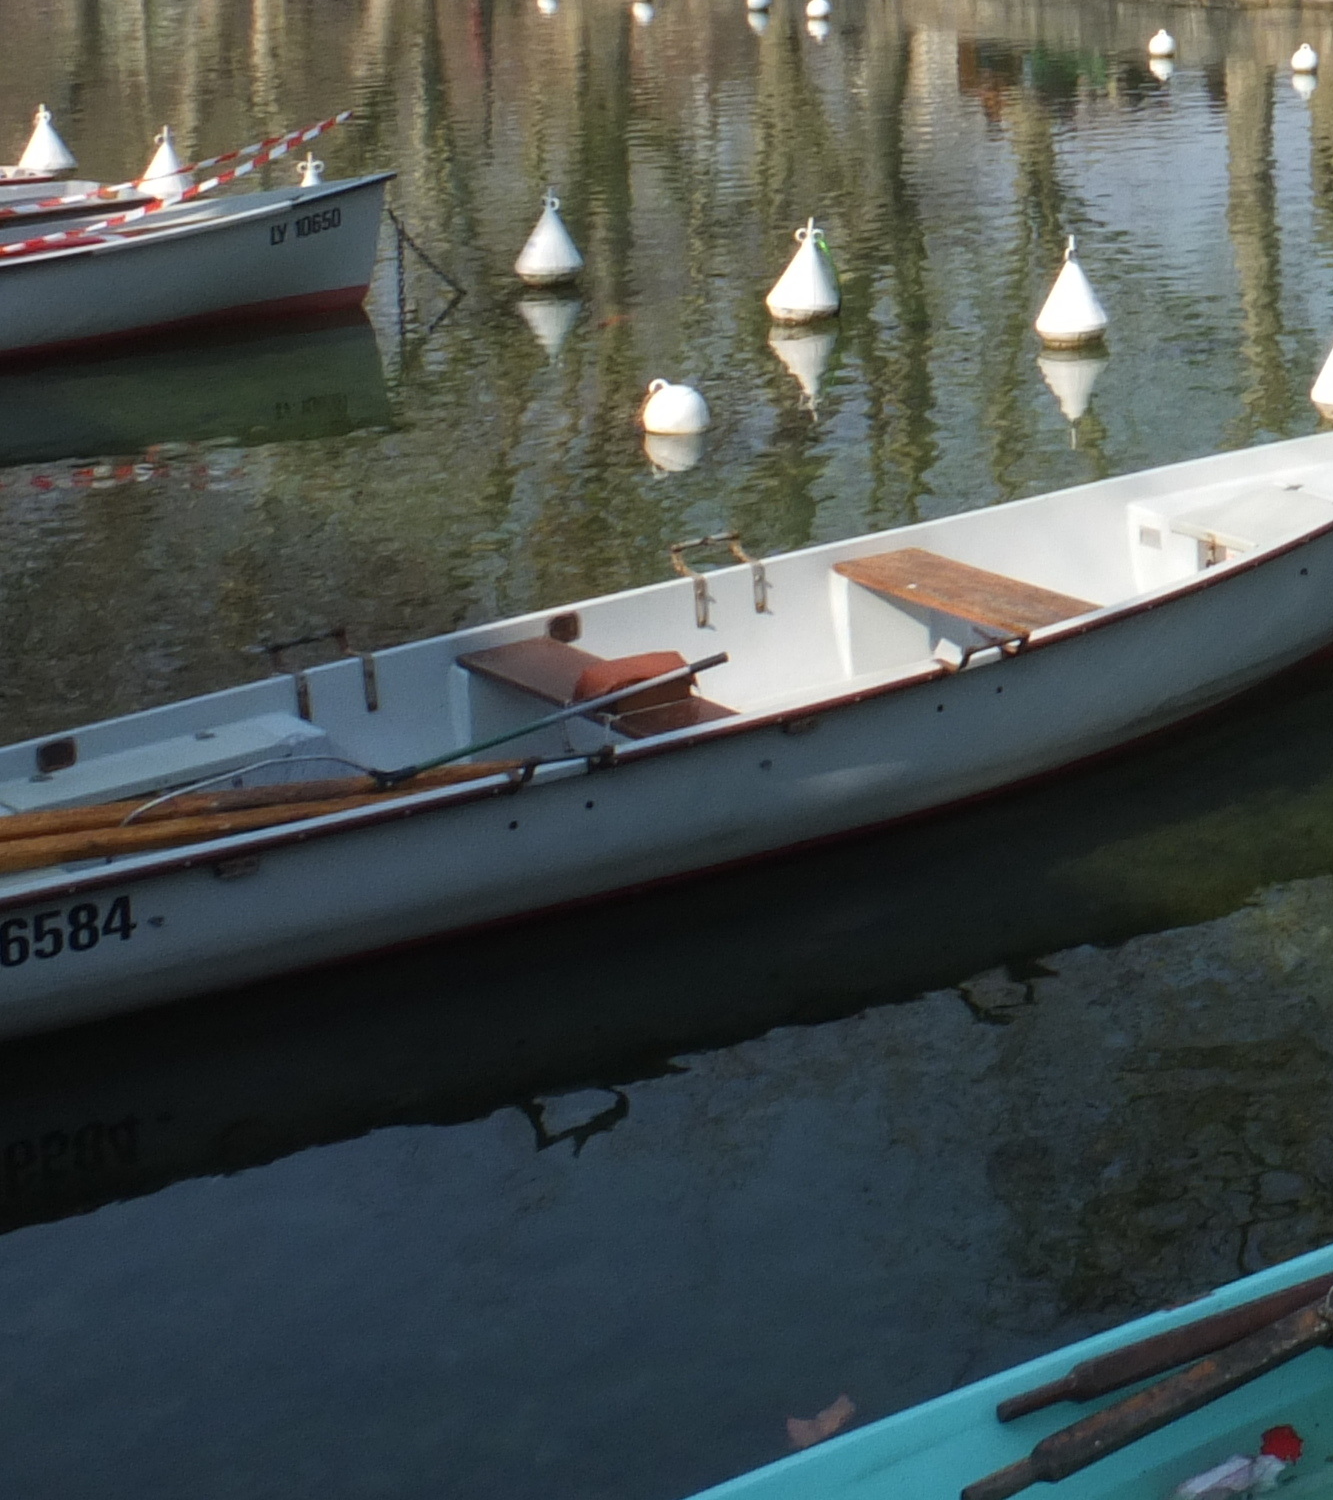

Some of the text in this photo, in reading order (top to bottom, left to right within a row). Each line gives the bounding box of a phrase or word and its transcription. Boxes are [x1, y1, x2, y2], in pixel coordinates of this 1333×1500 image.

[271, 207, 341, 245] LY 10650
[0, 895, 137, 967] 6584
